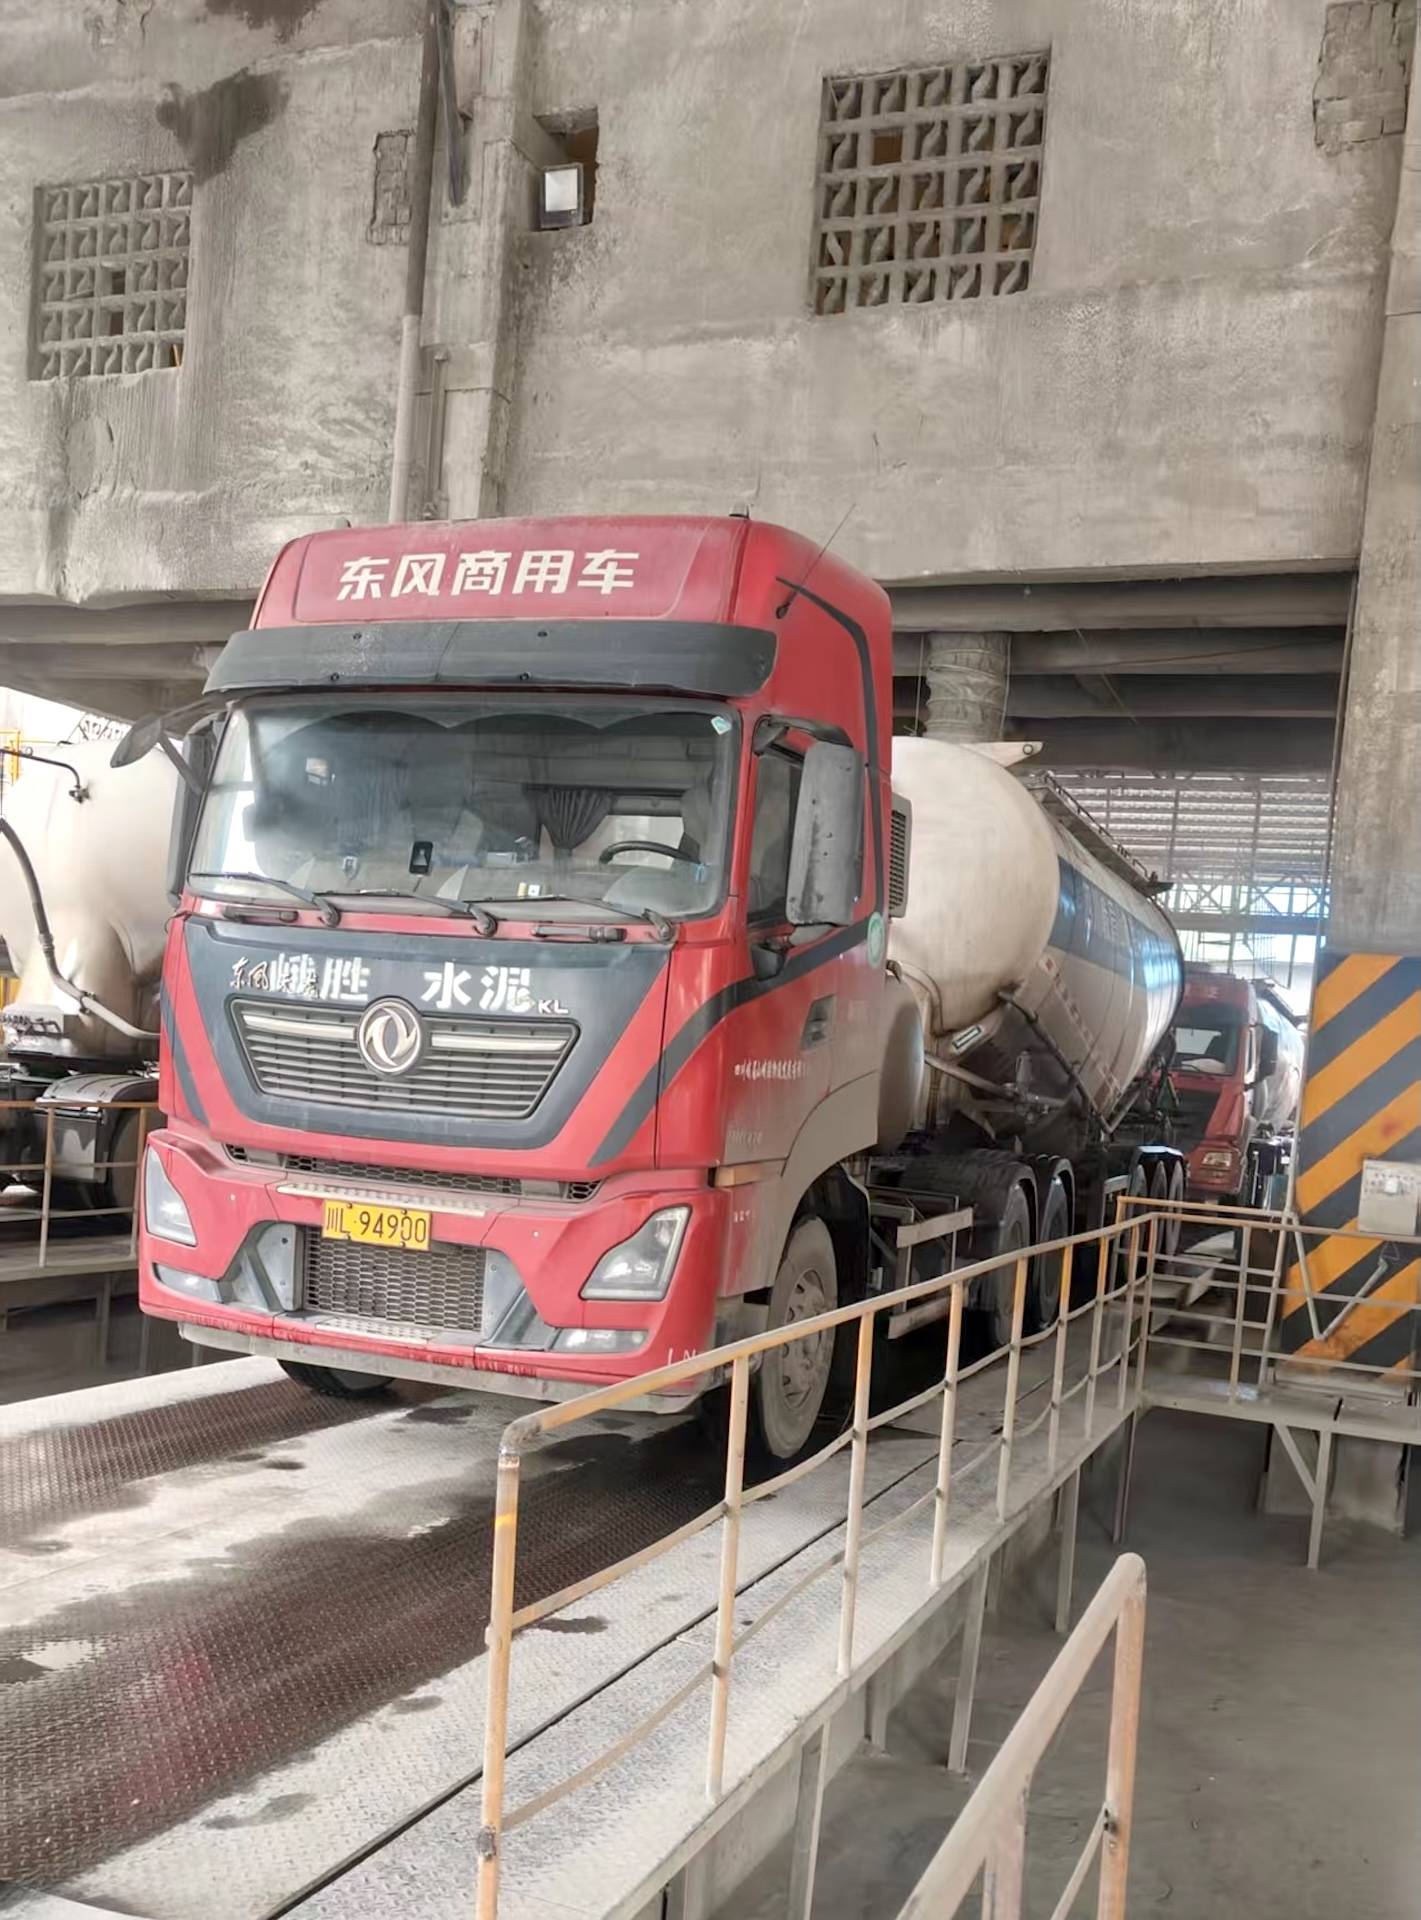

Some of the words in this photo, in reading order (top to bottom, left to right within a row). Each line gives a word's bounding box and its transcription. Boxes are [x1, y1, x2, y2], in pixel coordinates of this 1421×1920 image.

[336, 549, 640, 601] 东风商用车
[538, 999, 569, 1014] KL
